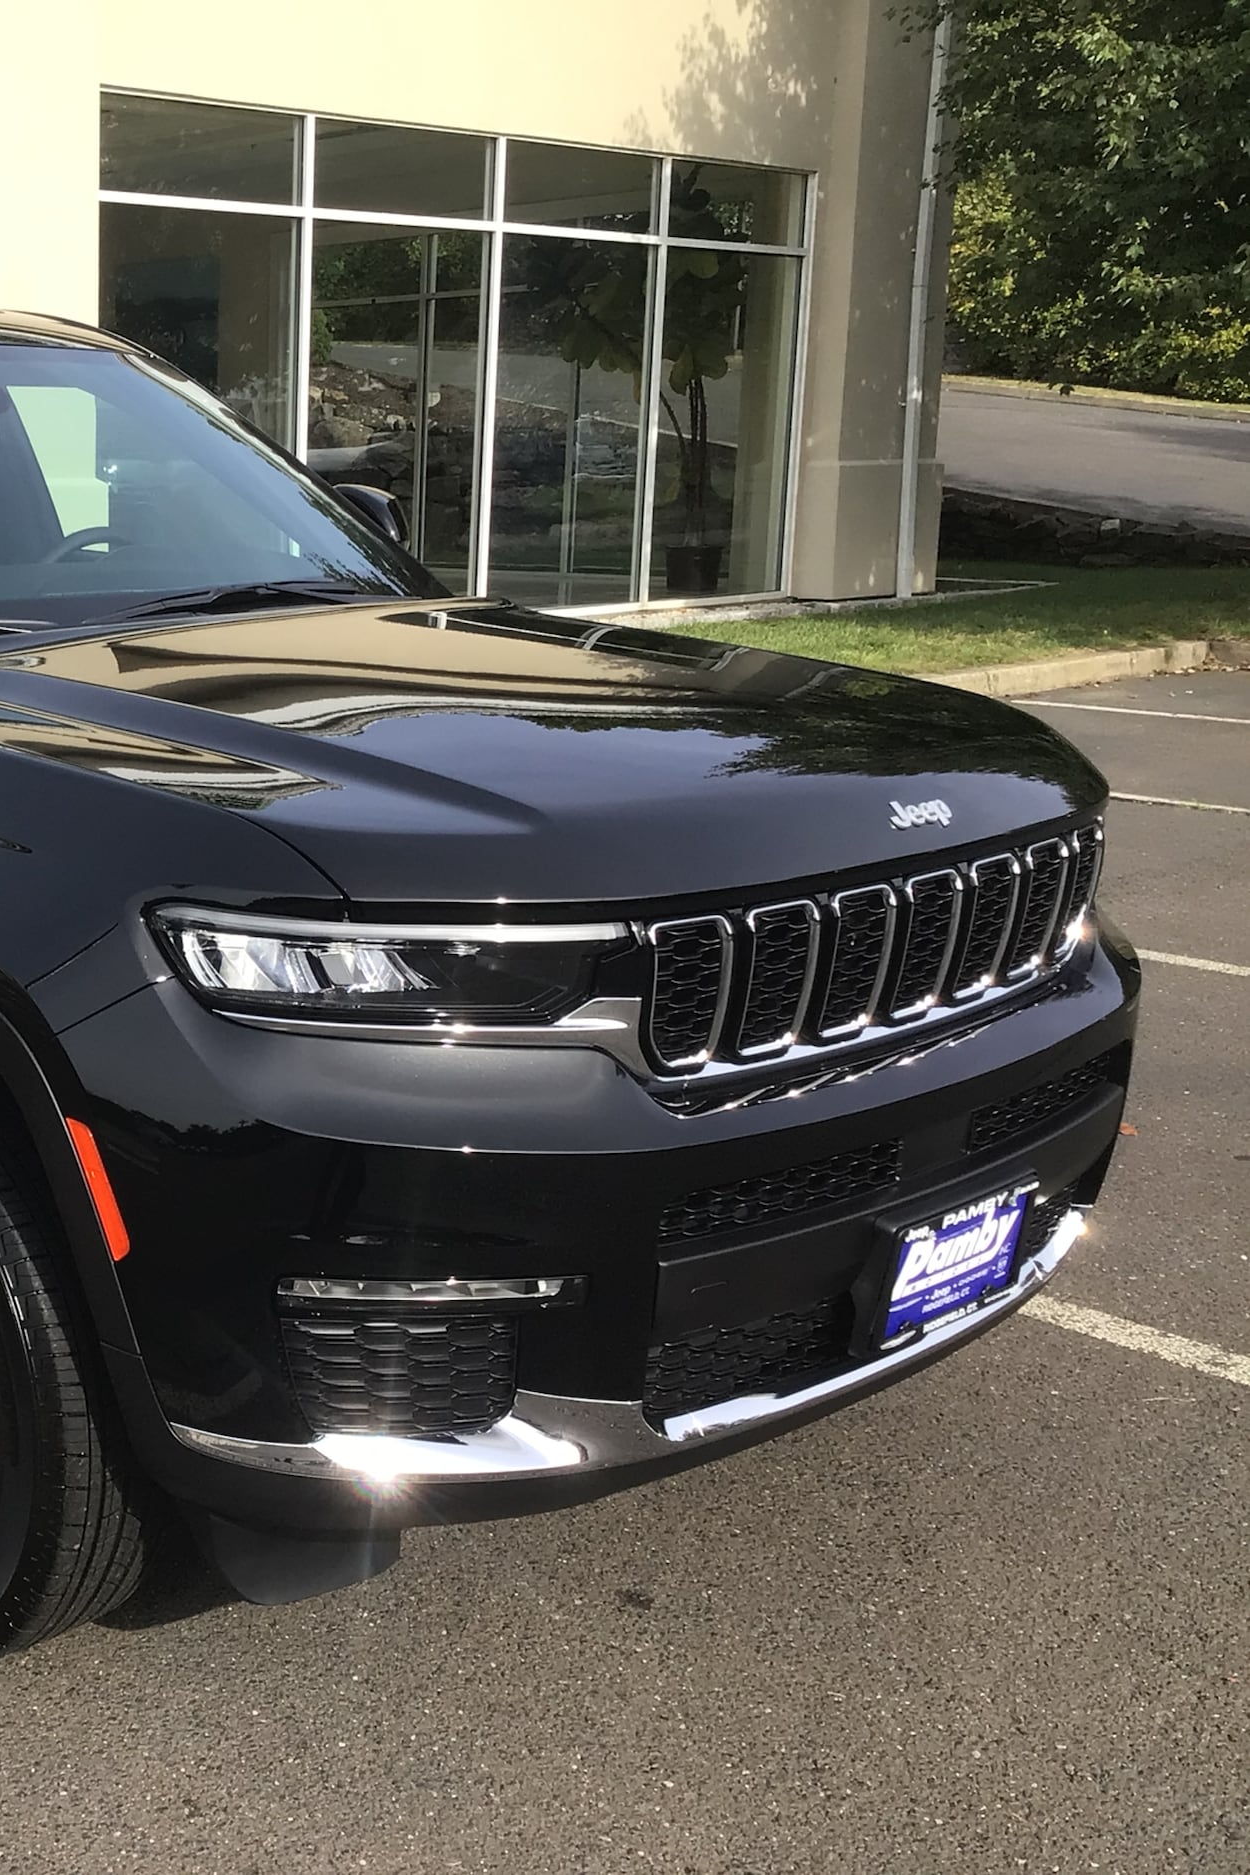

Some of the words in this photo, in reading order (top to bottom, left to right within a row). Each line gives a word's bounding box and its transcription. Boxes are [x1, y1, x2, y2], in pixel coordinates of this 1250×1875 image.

[889, 799, 953, 829] Jeep
[942, 1191, 1009, 1230] PAMBY
[890, 1209, 1021, 1302] Pamby
